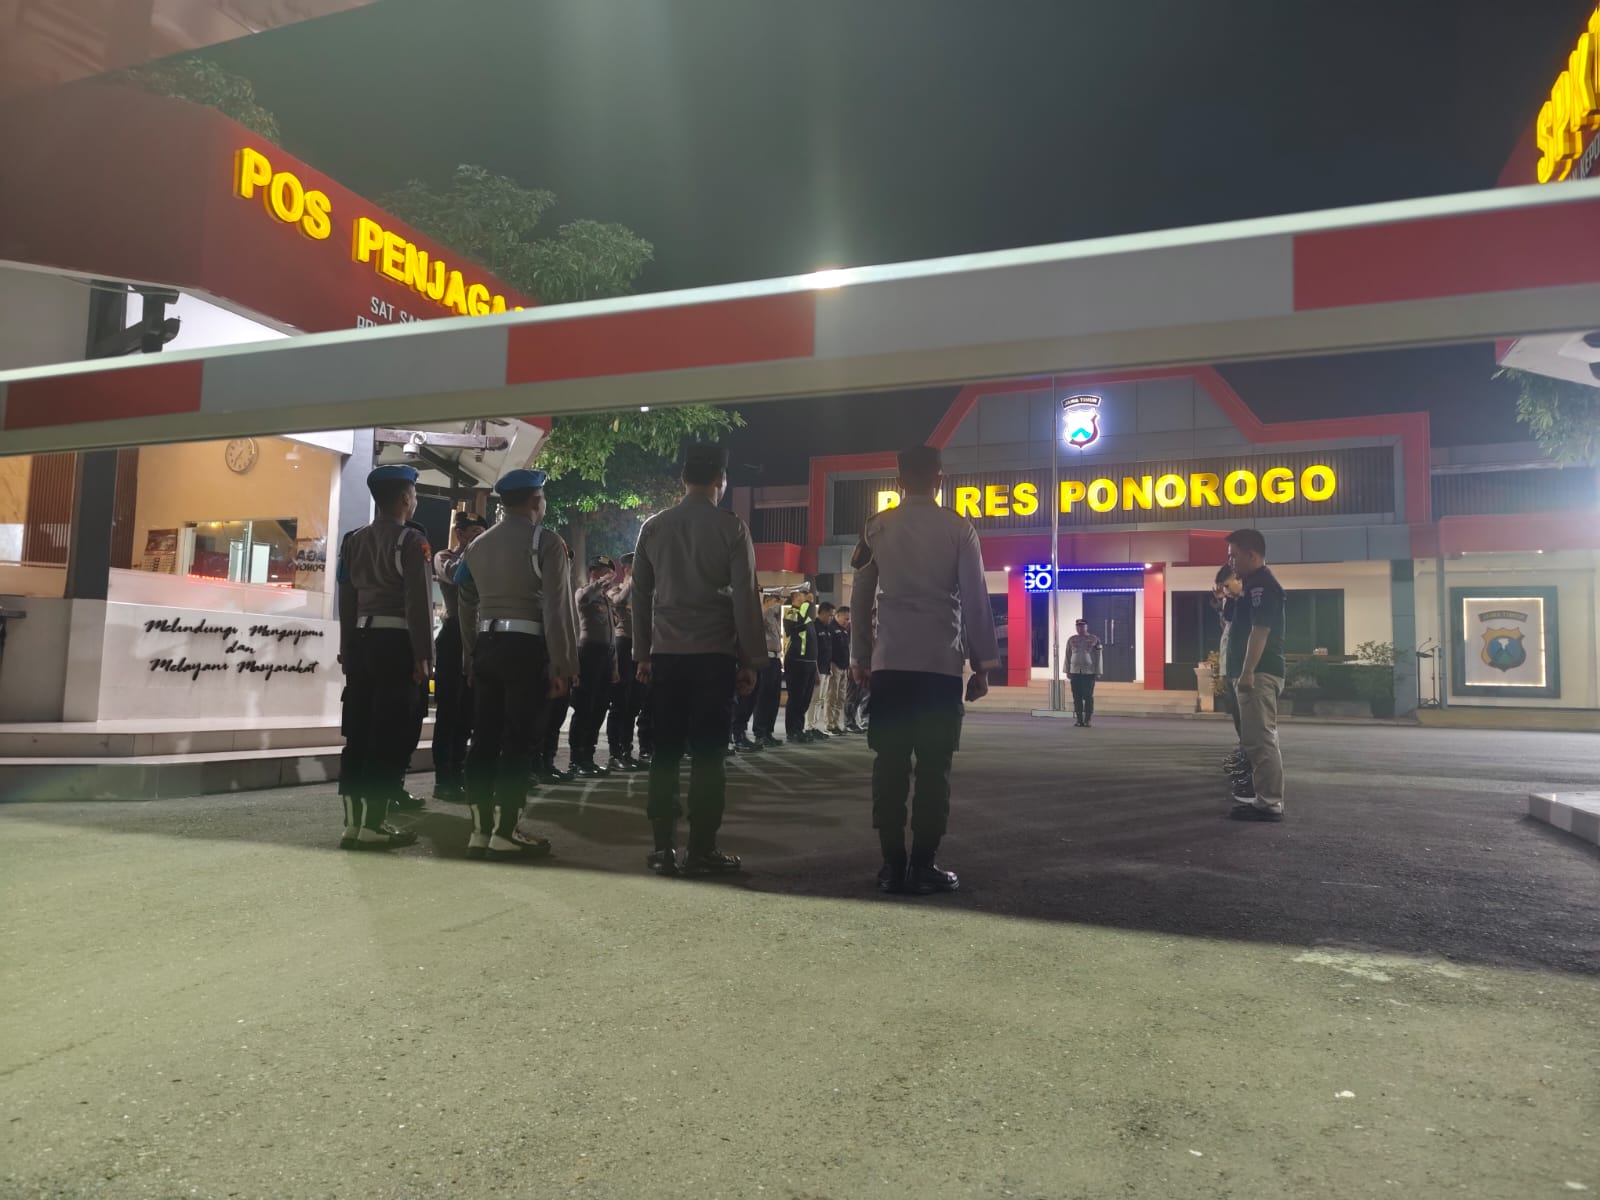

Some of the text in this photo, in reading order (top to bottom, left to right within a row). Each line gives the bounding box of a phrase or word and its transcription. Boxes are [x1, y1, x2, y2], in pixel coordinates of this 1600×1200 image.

[234, 147, 332, 240] POS
[370, 296, 395, 322] SAT
[877, 465, 1336, 518] PRES PONOROGO
[249, 624, 324, 645] Mengayomi
[225, 641, 255, 654] dan
[149, 657, 317, 680] Melayani Masyarakat
